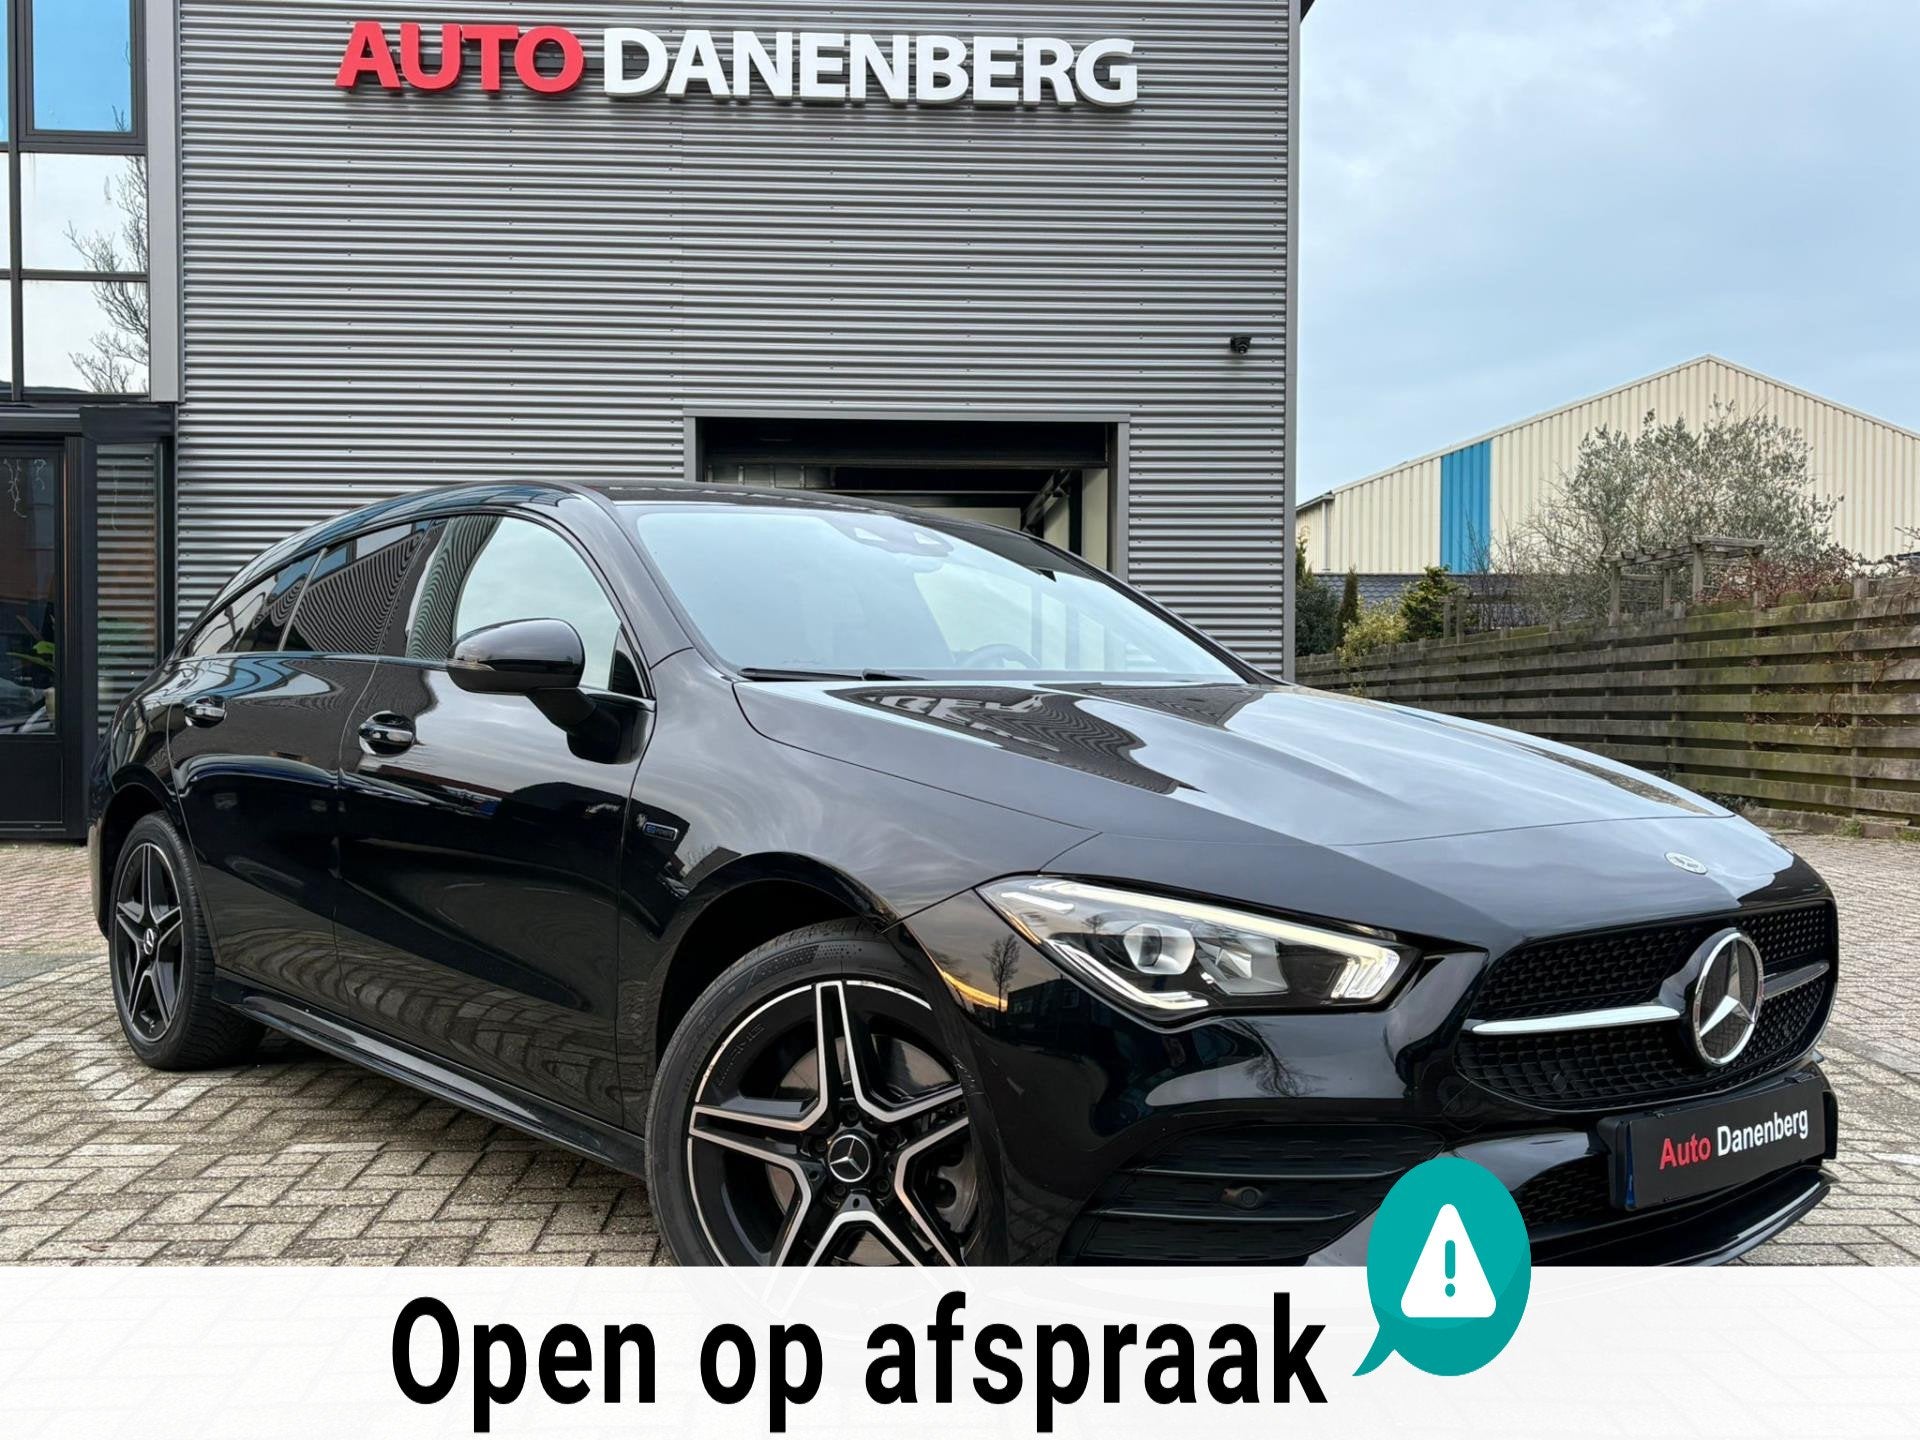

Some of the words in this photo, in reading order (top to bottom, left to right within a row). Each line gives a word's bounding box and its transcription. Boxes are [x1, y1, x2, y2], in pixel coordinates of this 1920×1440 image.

[334, 20, 585, 94] AUTO
[603, 26, 1139, 108] DANENBERG
[1659, 1133, 1712, 1170] Auto
[1717, 1109, 1809, 1157] Danenberg
